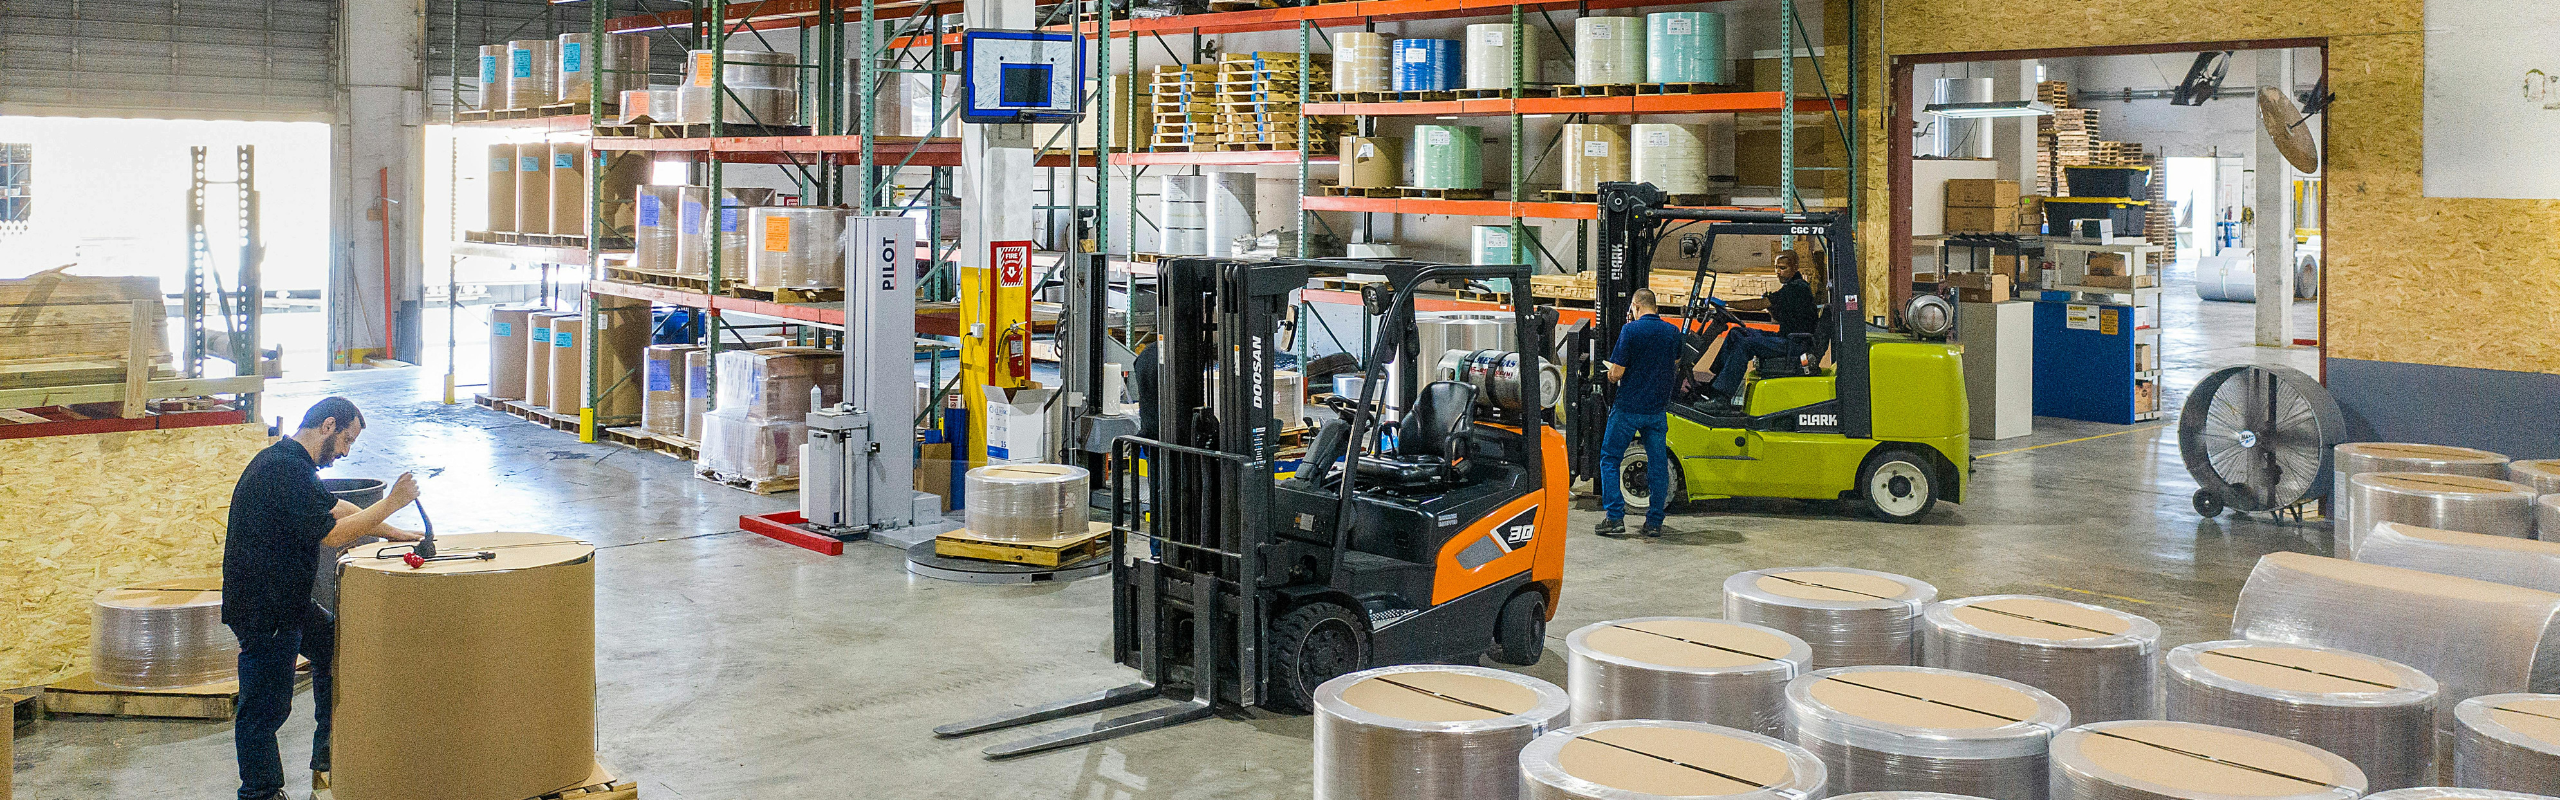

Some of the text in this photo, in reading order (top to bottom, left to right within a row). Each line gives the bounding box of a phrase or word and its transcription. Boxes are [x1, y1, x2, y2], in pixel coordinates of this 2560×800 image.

[1790, 226, 1824, 234] CGC 70
[882, 236, 895, 290] PILOT
[1611, 243, 1623, 280] CLARK
[1252, 335, 1263, 409] DOOSAN
[1798, 414, 1838, 426] CLARK
[1508, 524, 1535, 544] 30
